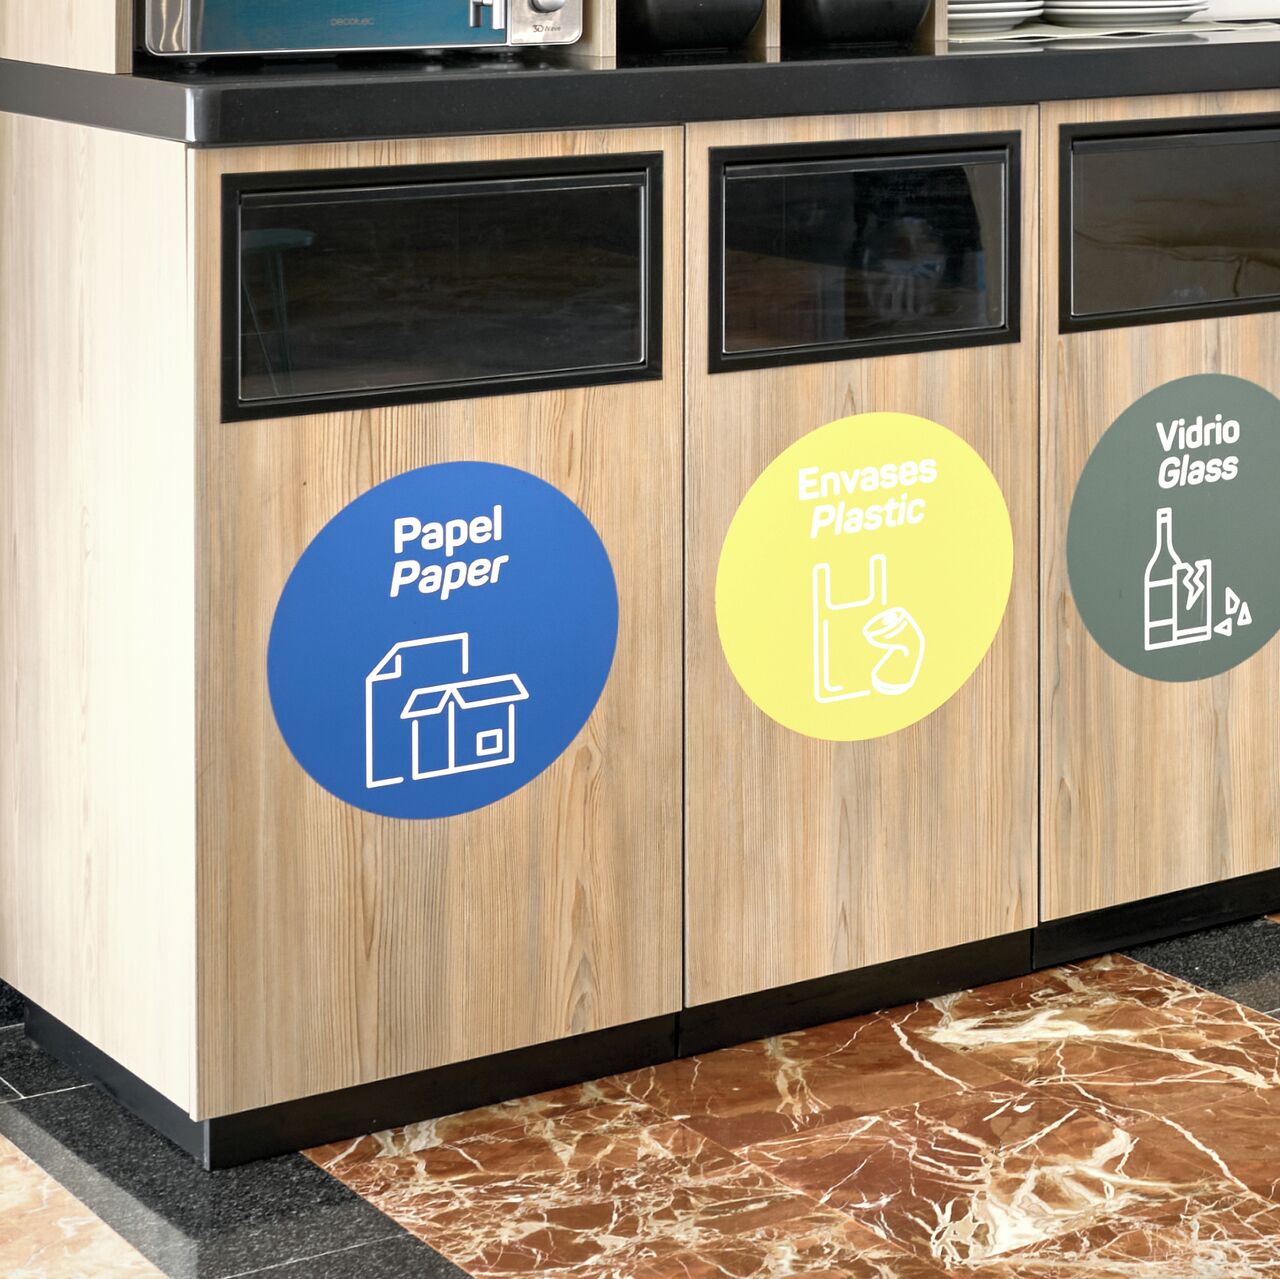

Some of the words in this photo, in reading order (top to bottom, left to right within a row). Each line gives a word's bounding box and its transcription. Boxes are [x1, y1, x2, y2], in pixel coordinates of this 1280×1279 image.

[1155, 413, 1240, 452] Vidrio
[798, 458, 938, 501] Envases
[1157, 454, 1240, 490] Glass
[394, 504, 502, 557] Papel
[809, 492, 926, 539] Plastic
[389, 555, 509, 601] Paper
